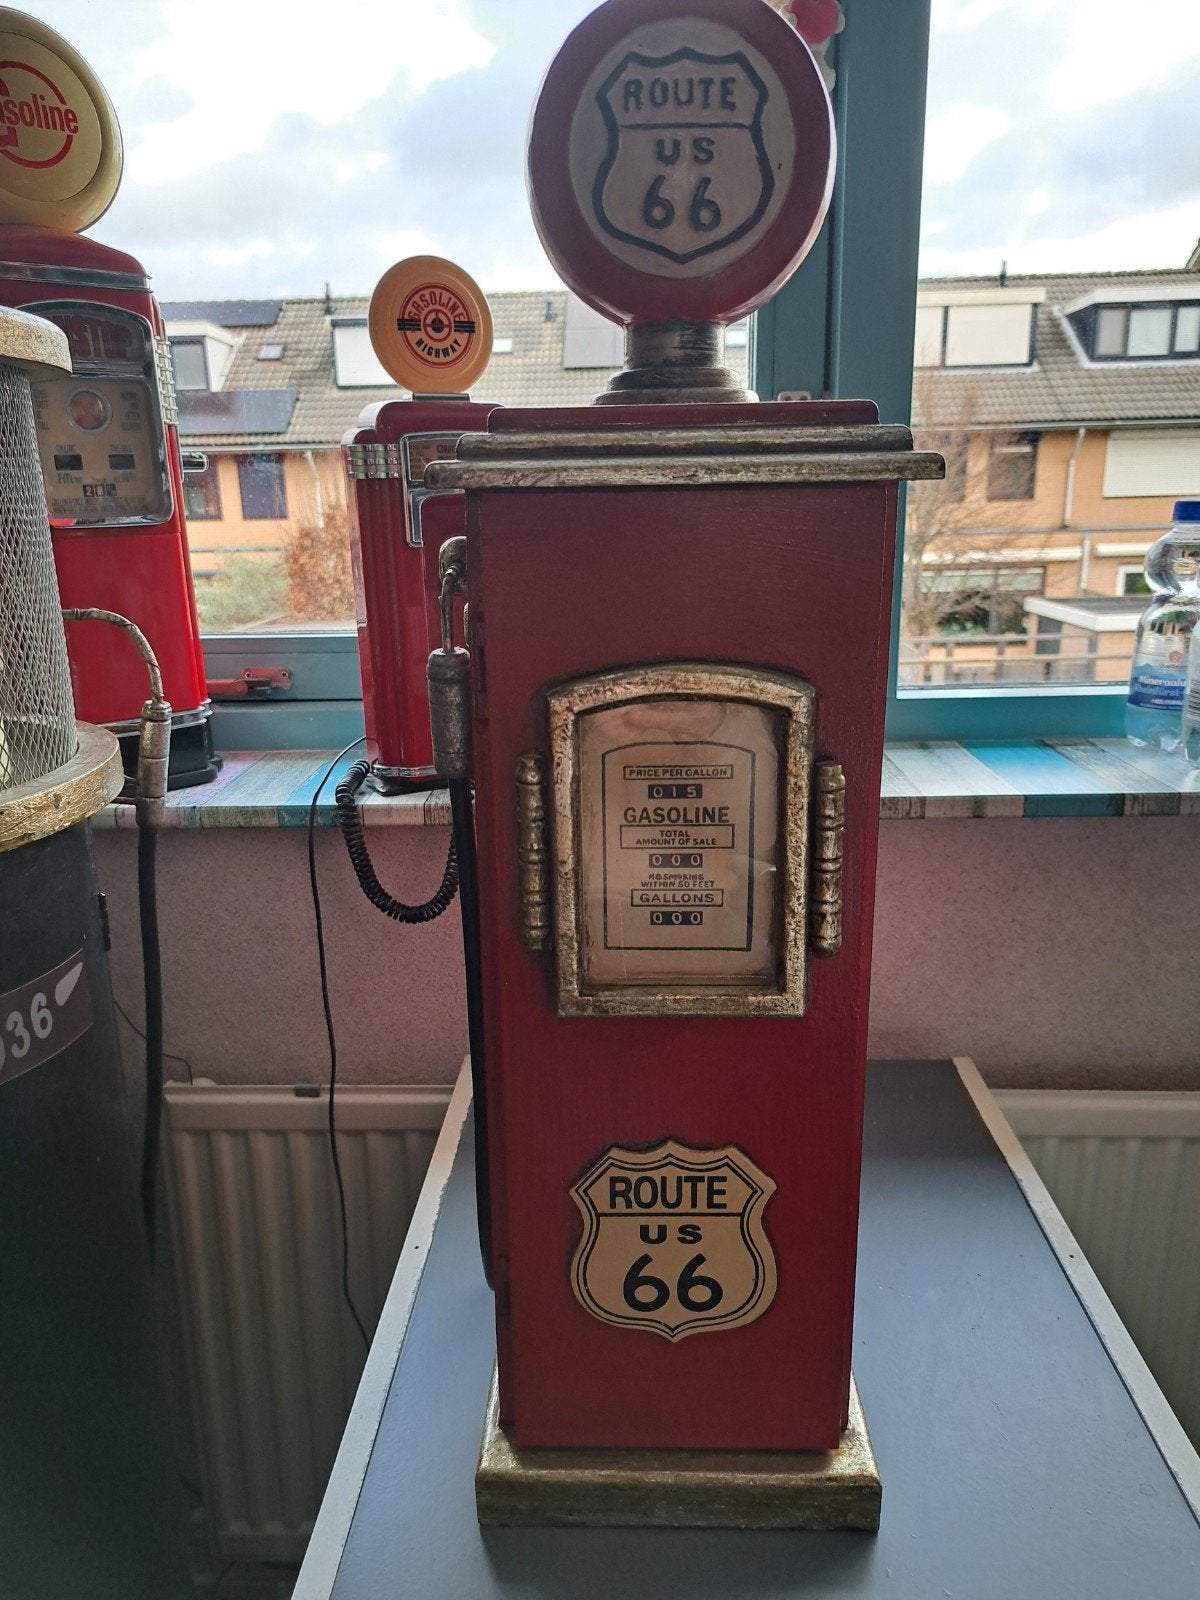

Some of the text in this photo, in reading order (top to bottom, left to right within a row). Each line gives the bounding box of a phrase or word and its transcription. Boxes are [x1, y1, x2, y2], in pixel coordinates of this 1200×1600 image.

[622, 76, 737, 112] ROUTE
[655, 137, 716, 165] US
[642, 174, 723, 232] 66
[408, 290, 466, 321] GASOLINE
[415, 338, 462, 359] HIGHWAY
[629, 768, 728, 777] PRICE PER GALLON
[623, 806, 730, 824] GASOLINE
[635, 838, 717, 846] AMOUNT OF SALE
[659, 830, 691, 838] TOTAL
[692, 880, 715, 888] FEET
[640, 893, 715, 903] GALLONS
[609, 1175, 728, 1209] ROUTE
[639, 1224, 703, 1244] US
[623, 1253, 723, 1312] 66
